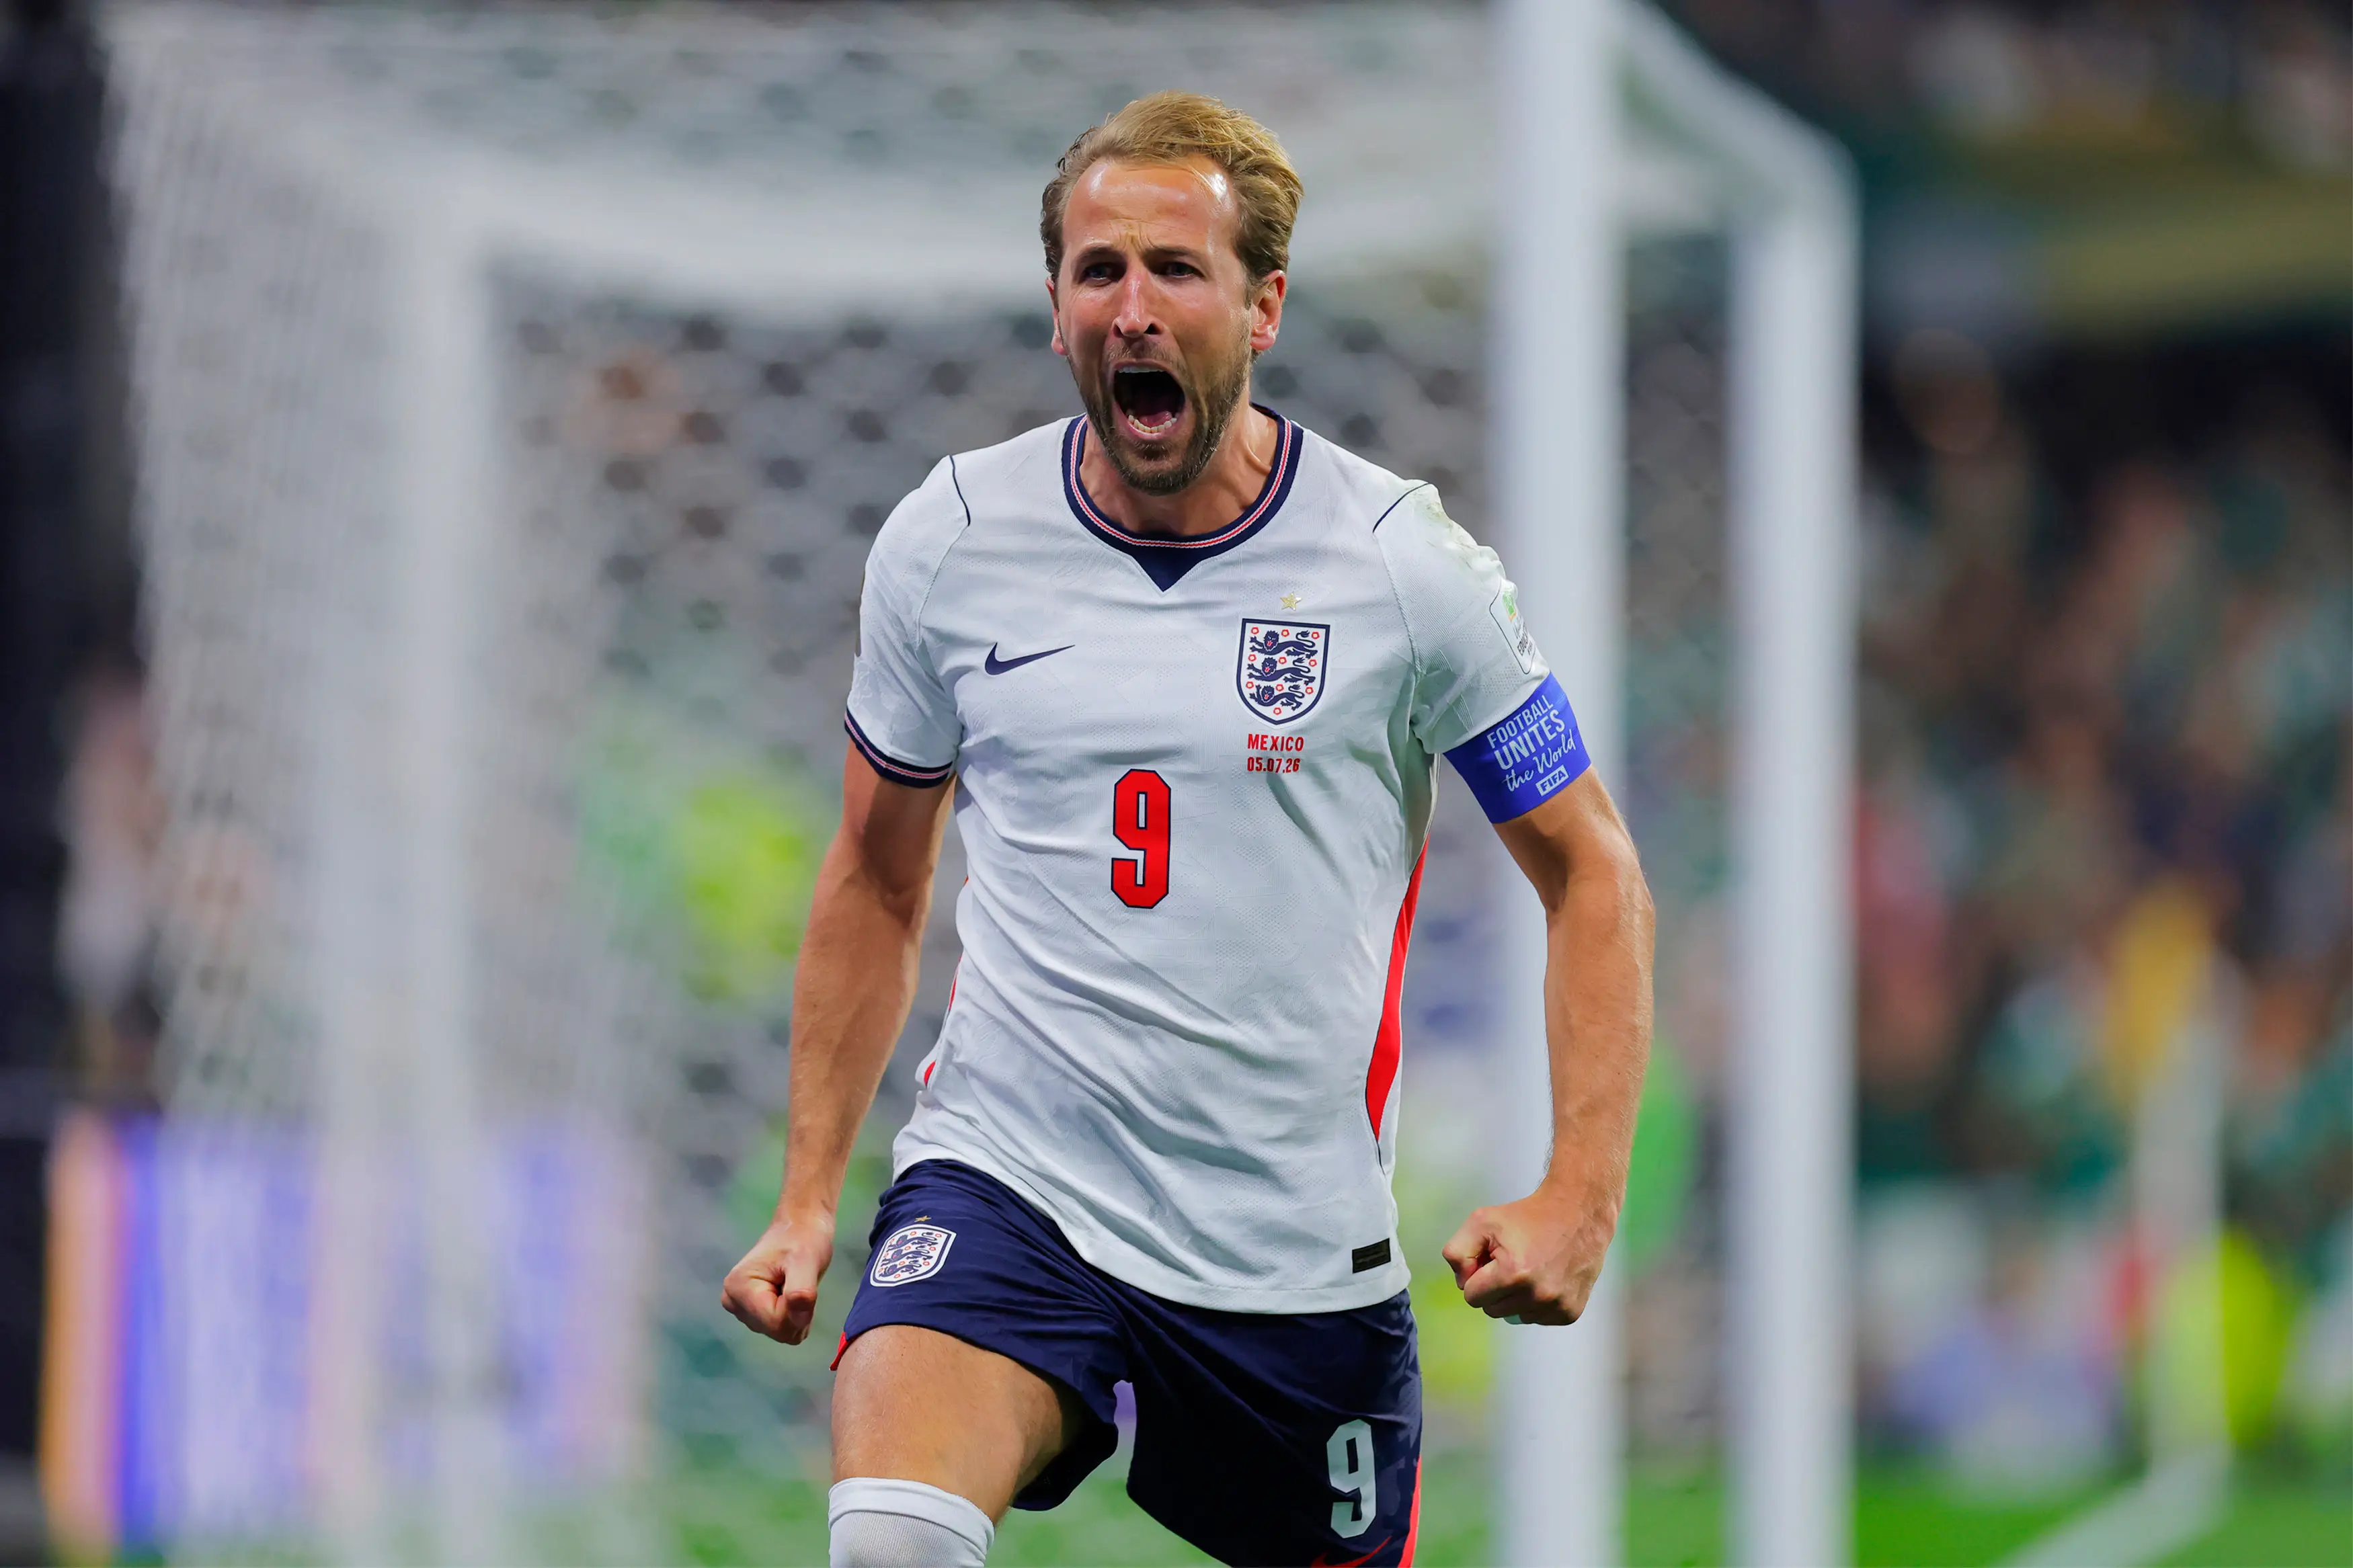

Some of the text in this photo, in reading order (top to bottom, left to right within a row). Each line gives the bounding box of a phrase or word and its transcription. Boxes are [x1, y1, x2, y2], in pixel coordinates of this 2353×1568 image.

[1247, 733, 1304, 751] MEXICO
[1486, 694, 1554, 749] FOOTBALL
[1494, 709, 1566, 770] UNITES
[1247, 756, 1301, 774] 05.07.26
[1502, 729, 1577, 792] the World
[1538, 766, 1568, 794] FIFA
[1111, 768, 1171, 909] 9
[1326, 1418, 1377, 1538] 9
